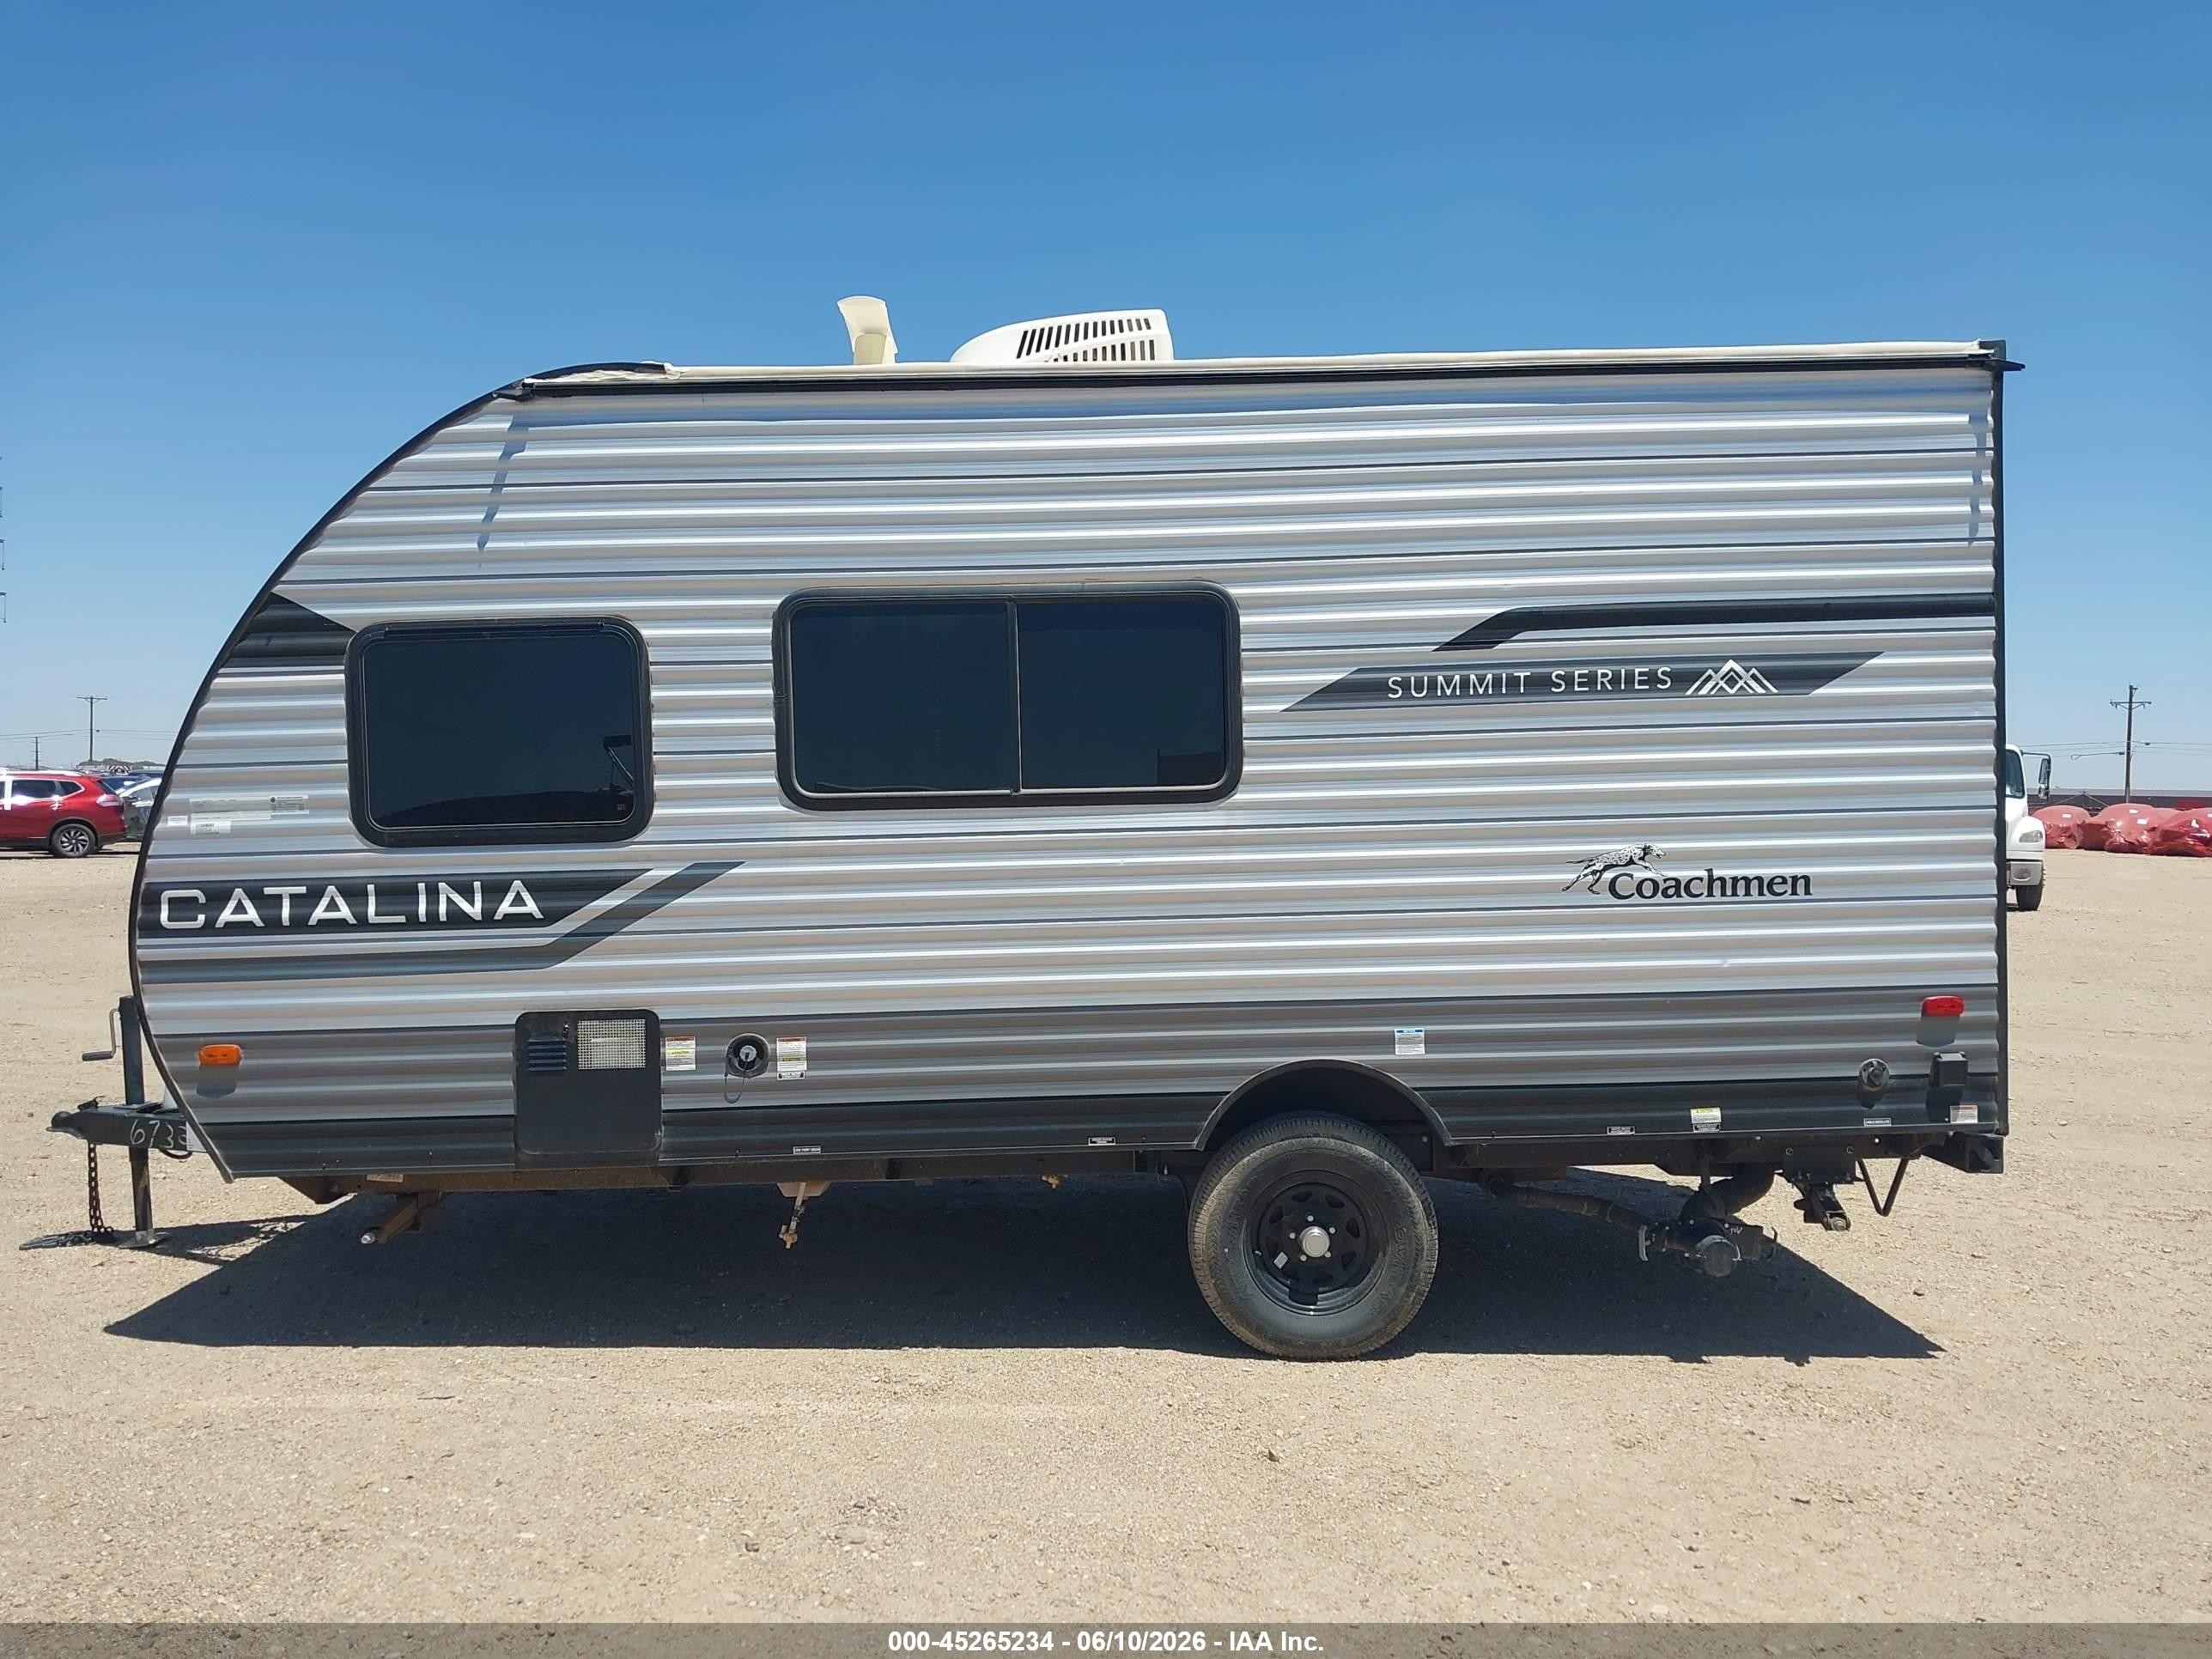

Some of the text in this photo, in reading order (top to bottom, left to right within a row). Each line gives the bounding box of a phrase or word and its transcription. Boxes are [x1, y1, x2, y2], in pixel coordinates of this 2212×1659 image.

[1387, 666, 1672, 699] SUMMIT SERIES
[1607, 867, 1813, 900] Coachmen
[160, 879, 544, 929] CATALINA
